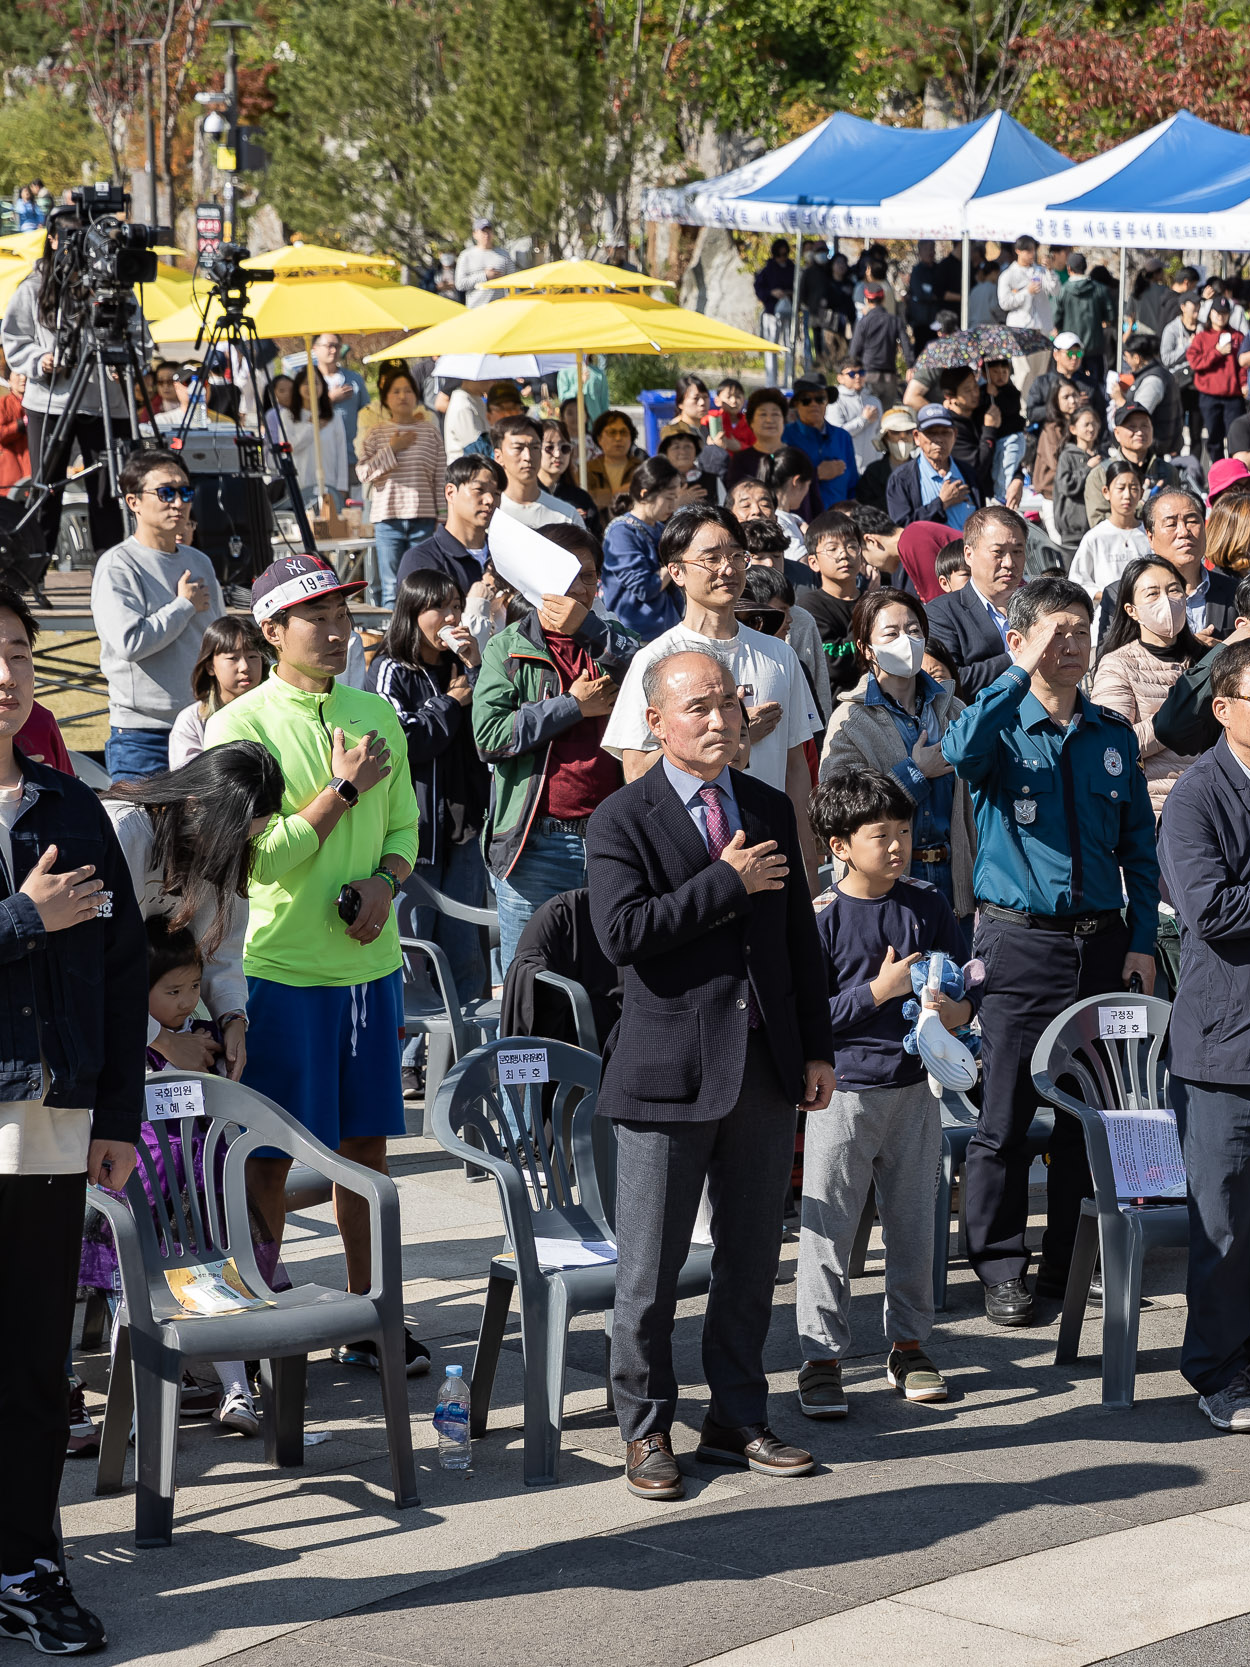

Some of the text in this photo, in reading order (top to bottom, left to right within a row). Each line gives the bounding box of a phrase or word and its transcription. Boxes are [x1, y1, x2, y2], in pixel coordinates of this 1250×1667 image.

[285, 559, 307, 576] NY
[298, 577, 318, 594] 19
[1110, 1010, 1134, 1020] 구청장
[499, 1052, 546, 1065] 문화행사위원회
[154, 1085, 192, 1099] 국회의원
